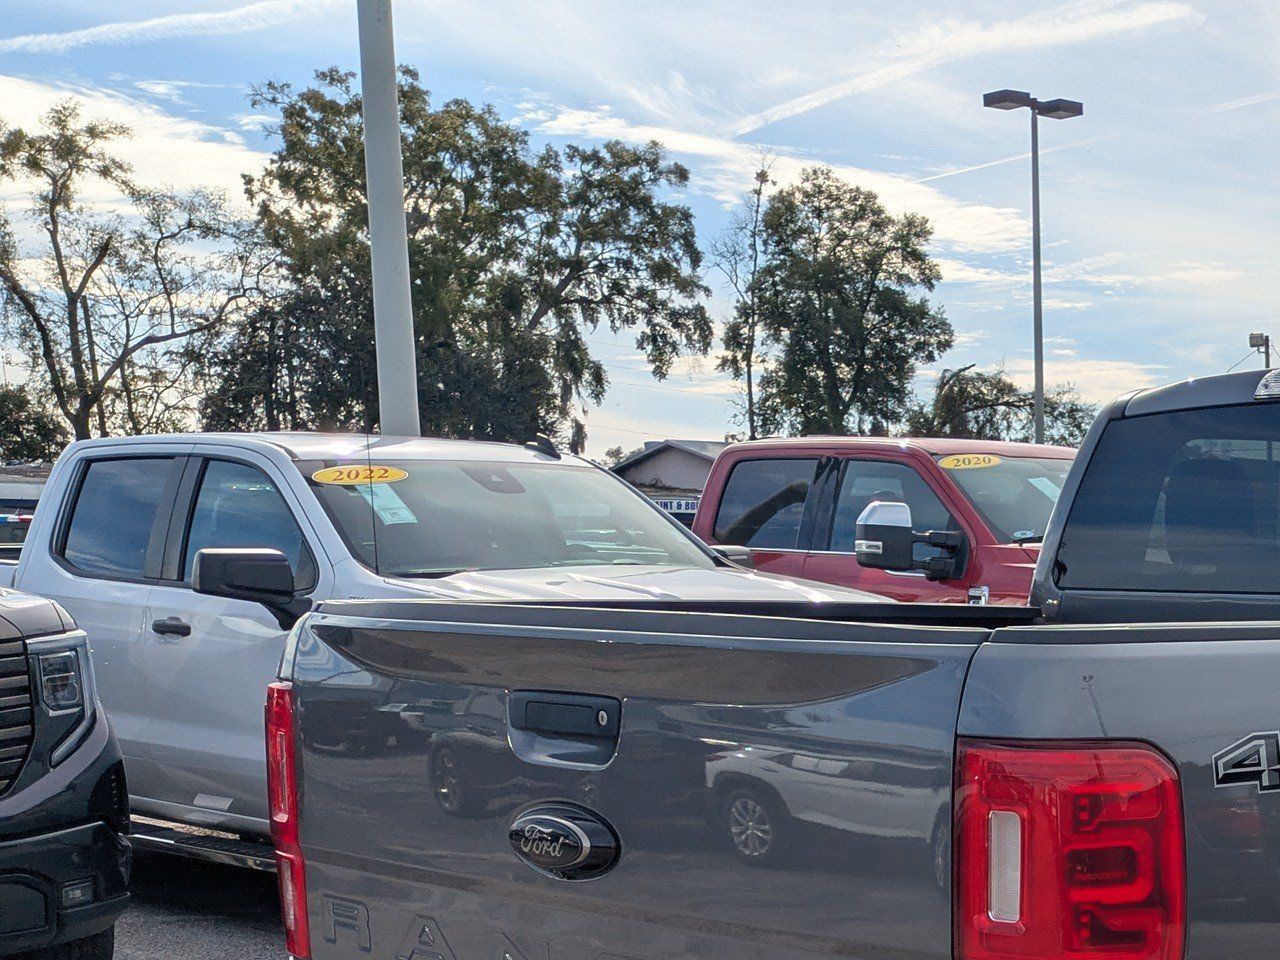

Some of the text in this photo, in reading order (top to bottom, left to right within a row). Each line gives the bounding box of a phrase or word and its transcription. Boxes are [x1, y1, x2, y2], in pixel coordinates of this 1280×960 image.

[952, 456, 991, 467] 2020
[332, 468, 389, 481] 2022
[655, 501, 673, 510] INT
[521, 824, 563, 857] Ford
